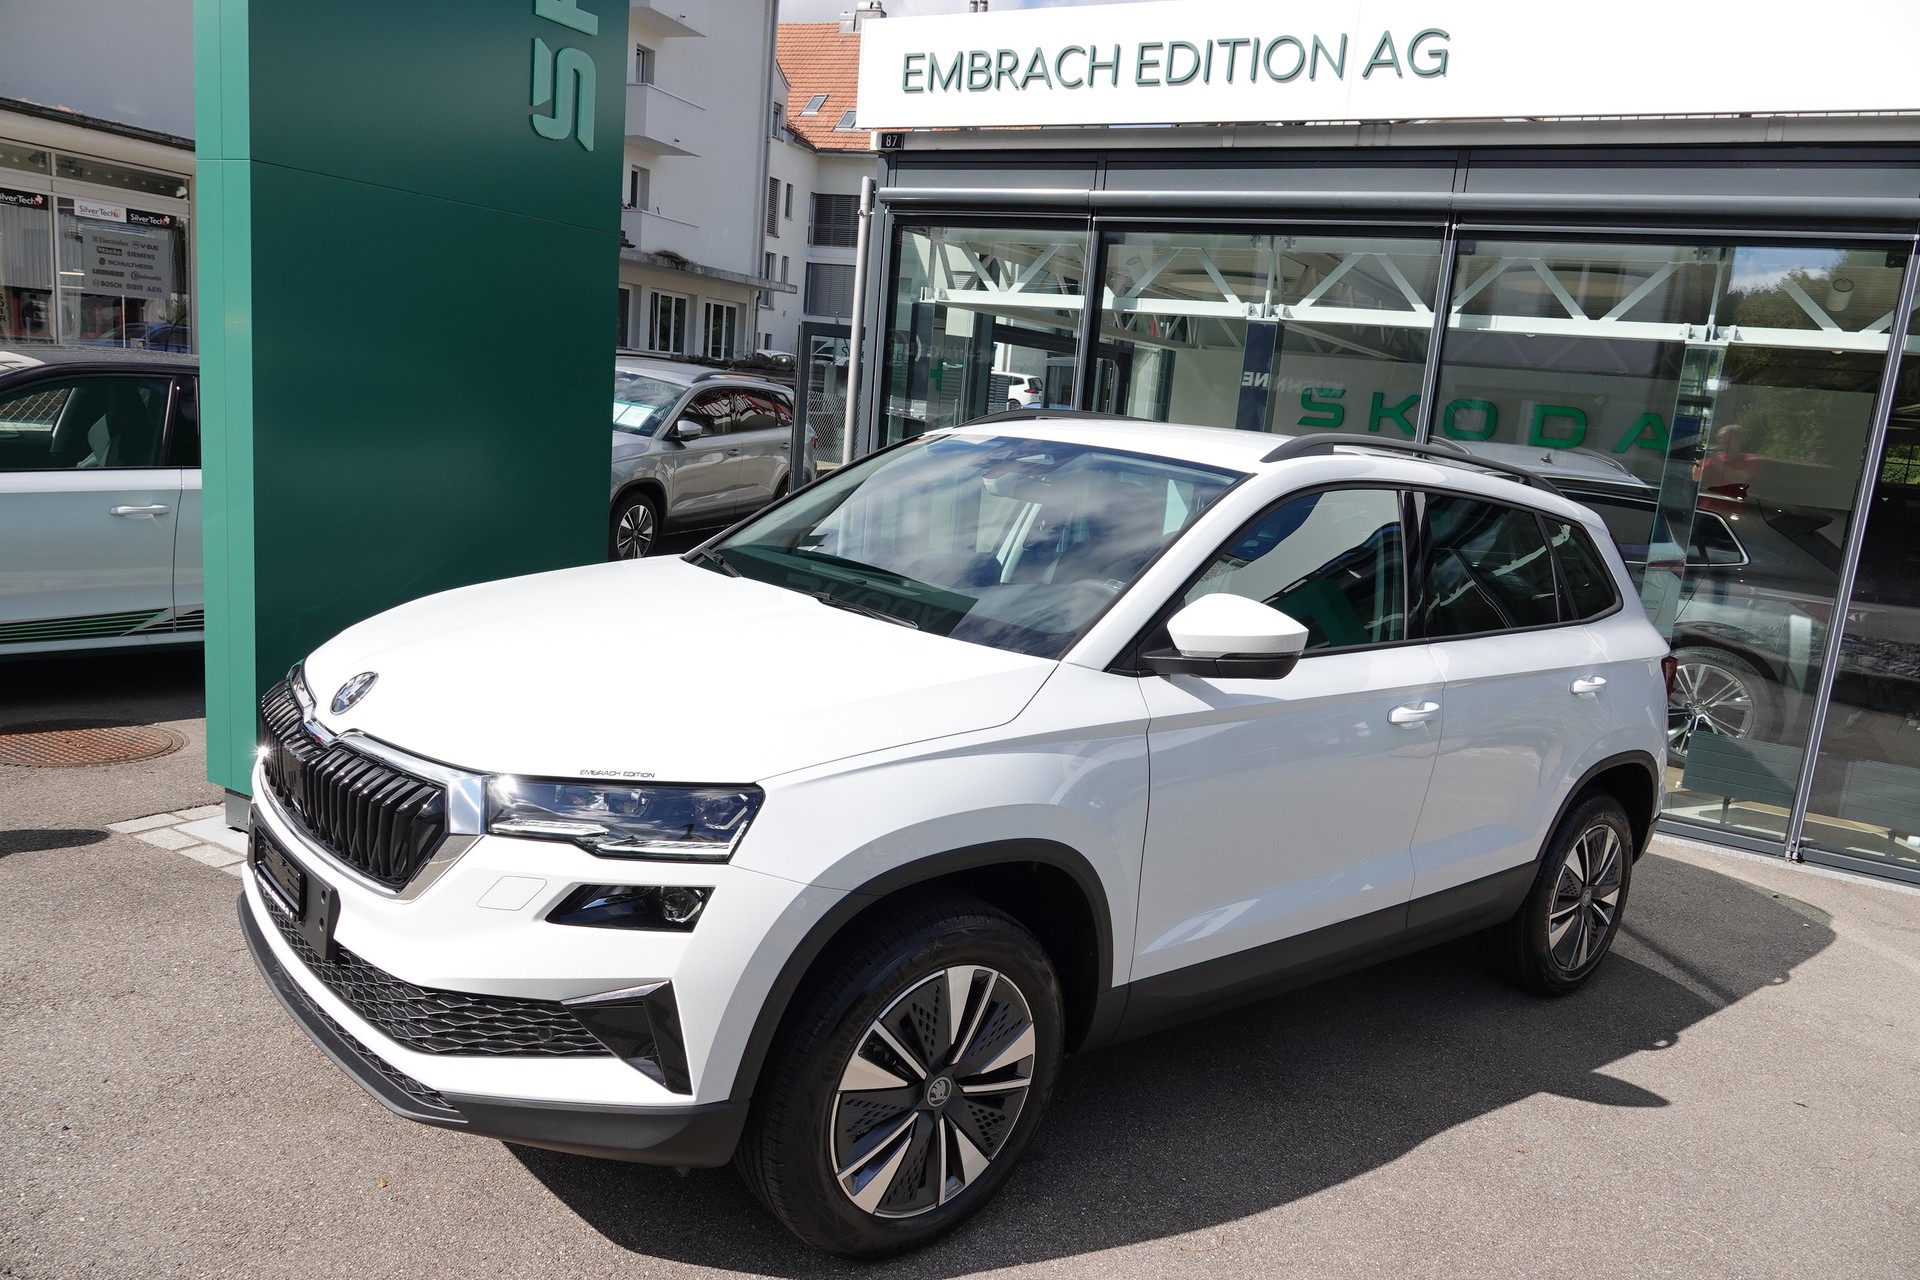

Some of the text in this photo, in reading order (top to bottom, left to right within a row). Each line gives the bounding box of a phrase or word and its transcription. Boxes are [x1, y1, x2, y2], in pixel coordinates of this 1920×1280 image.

[902, 27, 1451, 93] EMBRACH EDITION AG
[885, 134, 898, 147] 87
[0, 192, 37, 206] ilverTech
[99, 236, 160, 251] Electrolux V-ZUG
[97, 246, 156, 261] Miele SIEMENS
[107, 259, 154, 271] SCHULTHESS
[100, 280, 122, 289] BOSCH
